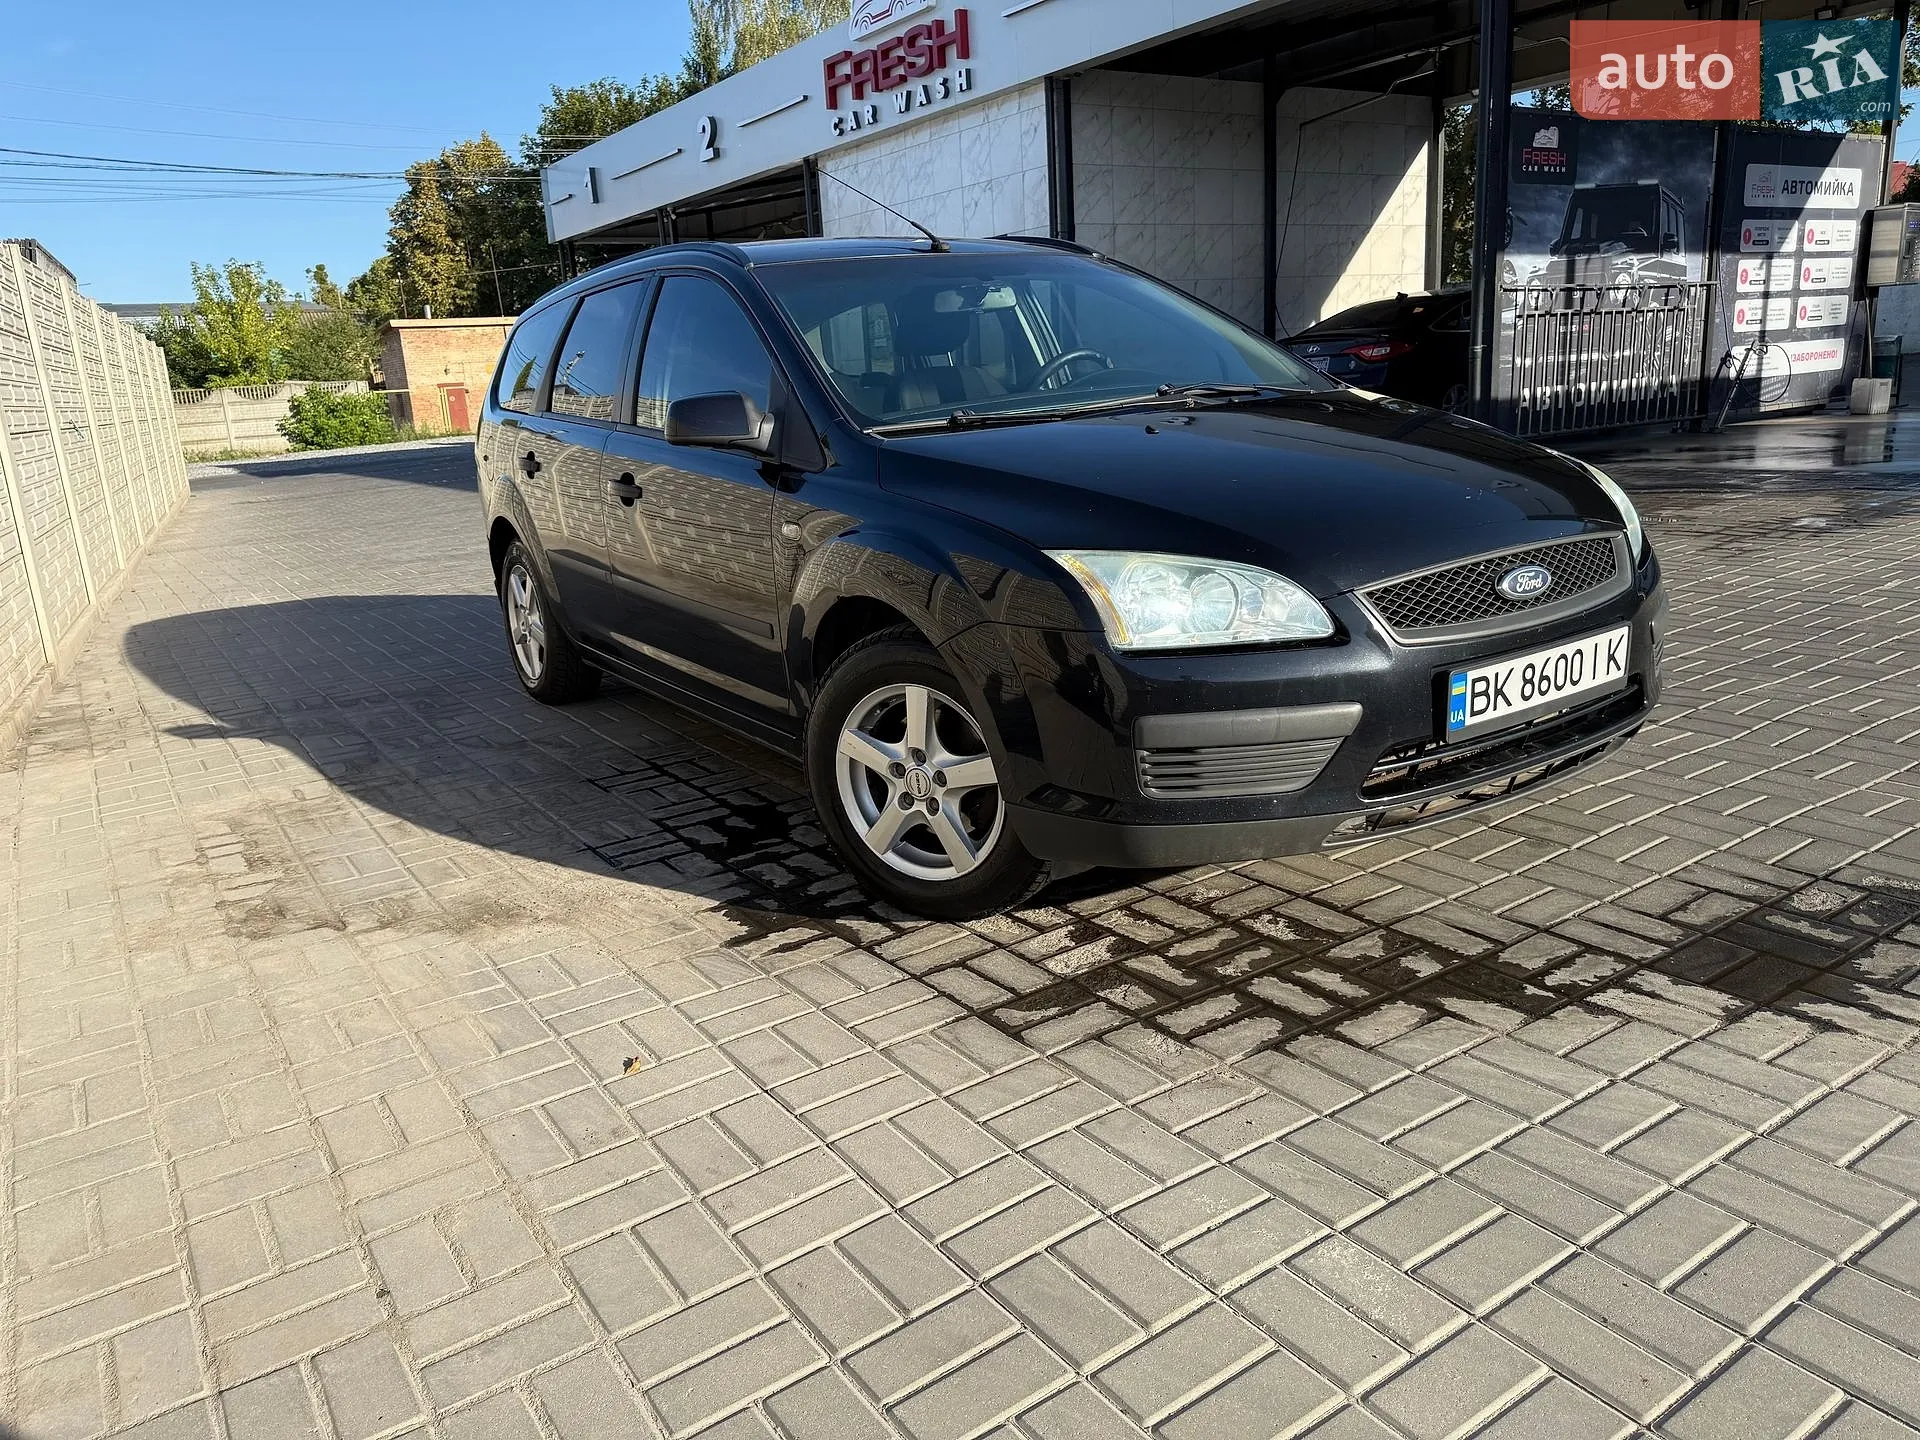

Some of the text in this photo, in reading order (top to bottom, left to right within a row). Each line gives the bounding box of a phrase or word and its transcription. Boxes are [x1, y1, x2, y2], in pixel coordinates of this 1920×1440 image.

[823, 8, 970, 110] FRESH
[831, 68, 972, 137] CAR WASH
[697, 115, 721, 163] 2
[1522, 148, 1567, 165] FRESH
[1522, 164, 1566, 173] CAR WASH
[583, 166, 600, 204] 1
[1781, 178, 1854, 197] АВТОМИЙКА
[1516, 572, 1543, 593] Ford
[1469, 667, 1516, 718] BK
[1520, 648, 1584, 702] 8600
[1450, 709, 1465, 724] UA
